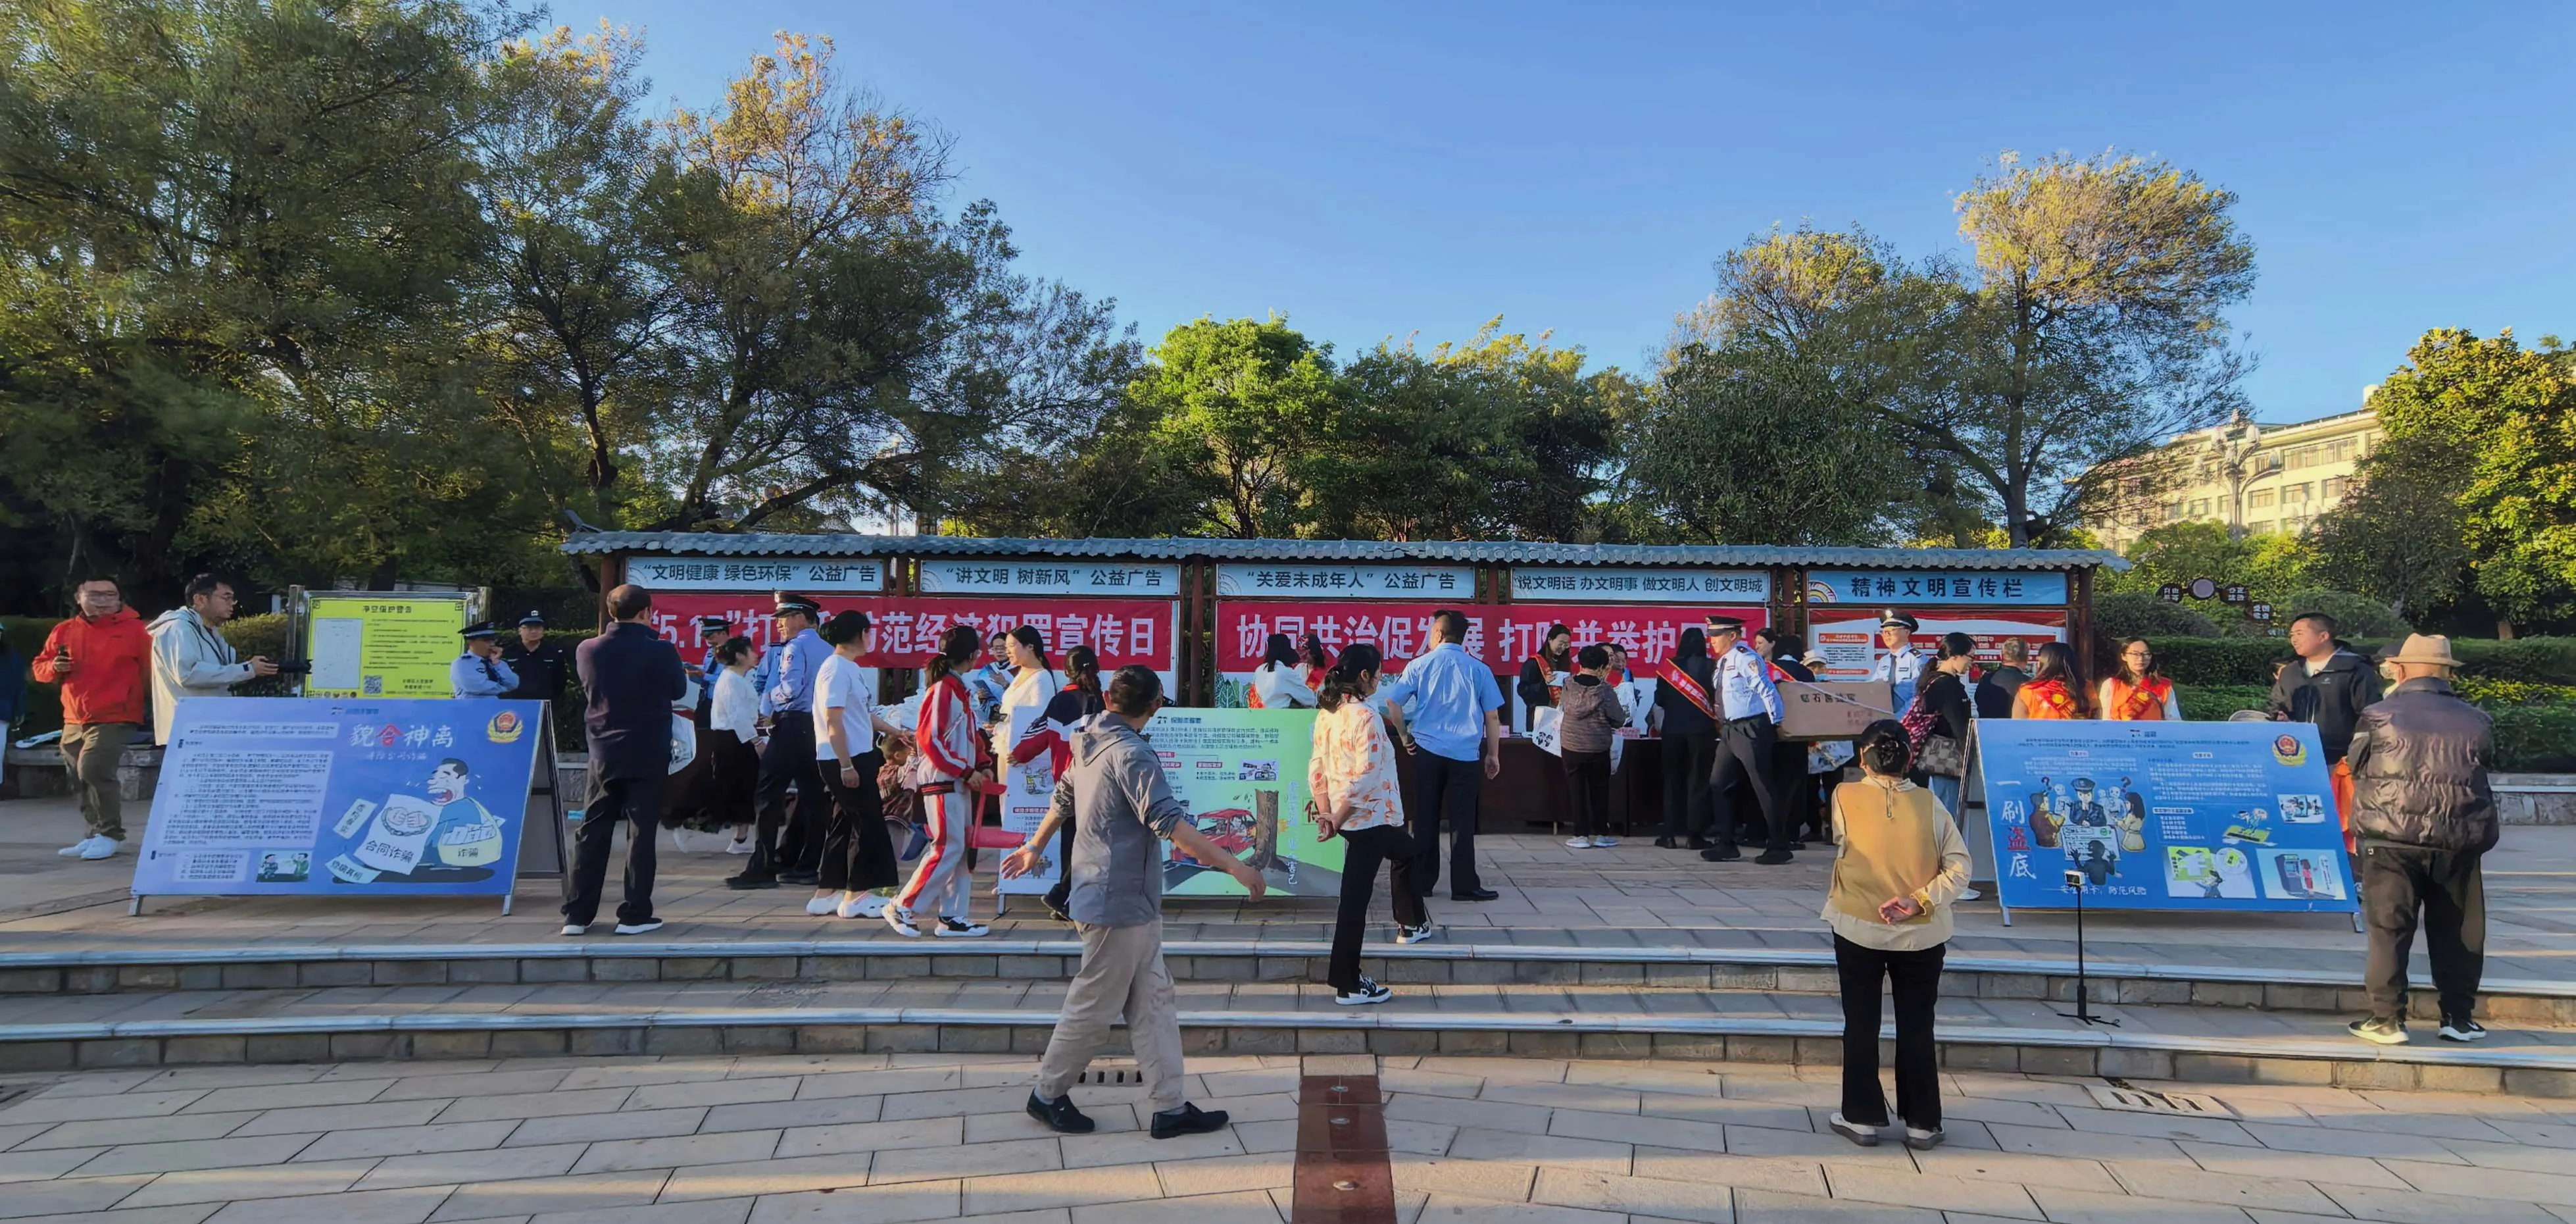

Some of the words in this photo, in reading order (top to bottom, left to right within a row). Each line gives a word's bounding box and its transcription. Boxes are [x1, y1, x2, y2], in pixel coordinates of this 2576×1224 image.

[643, 564, 720, 582] “文明健康
[724, 564, 800, 582] 绿色环保”
[808, 565, 876, 583] 公益广告
[946, 567, 1009, 585] “讲文明
[1090, 569, 1162, 587] 公益广告
[1247, 571, 1374, 589] “关爱未成年人”
[1383, 572, 1456, 590] 公益广告
[1579, 576, 1639, 591] 办文明事
[1642, 576, 1699, 592] 做文明人
[1704, 578, 1763, 593] 创文明城
[1850, 576, 2023, 598] 精神文明宣传栏
[350, 723, 455, 749] 貌合神离
[364, 839, 415, 864] 合同诈骗
[457, 846, 479, 858] 诈骗
